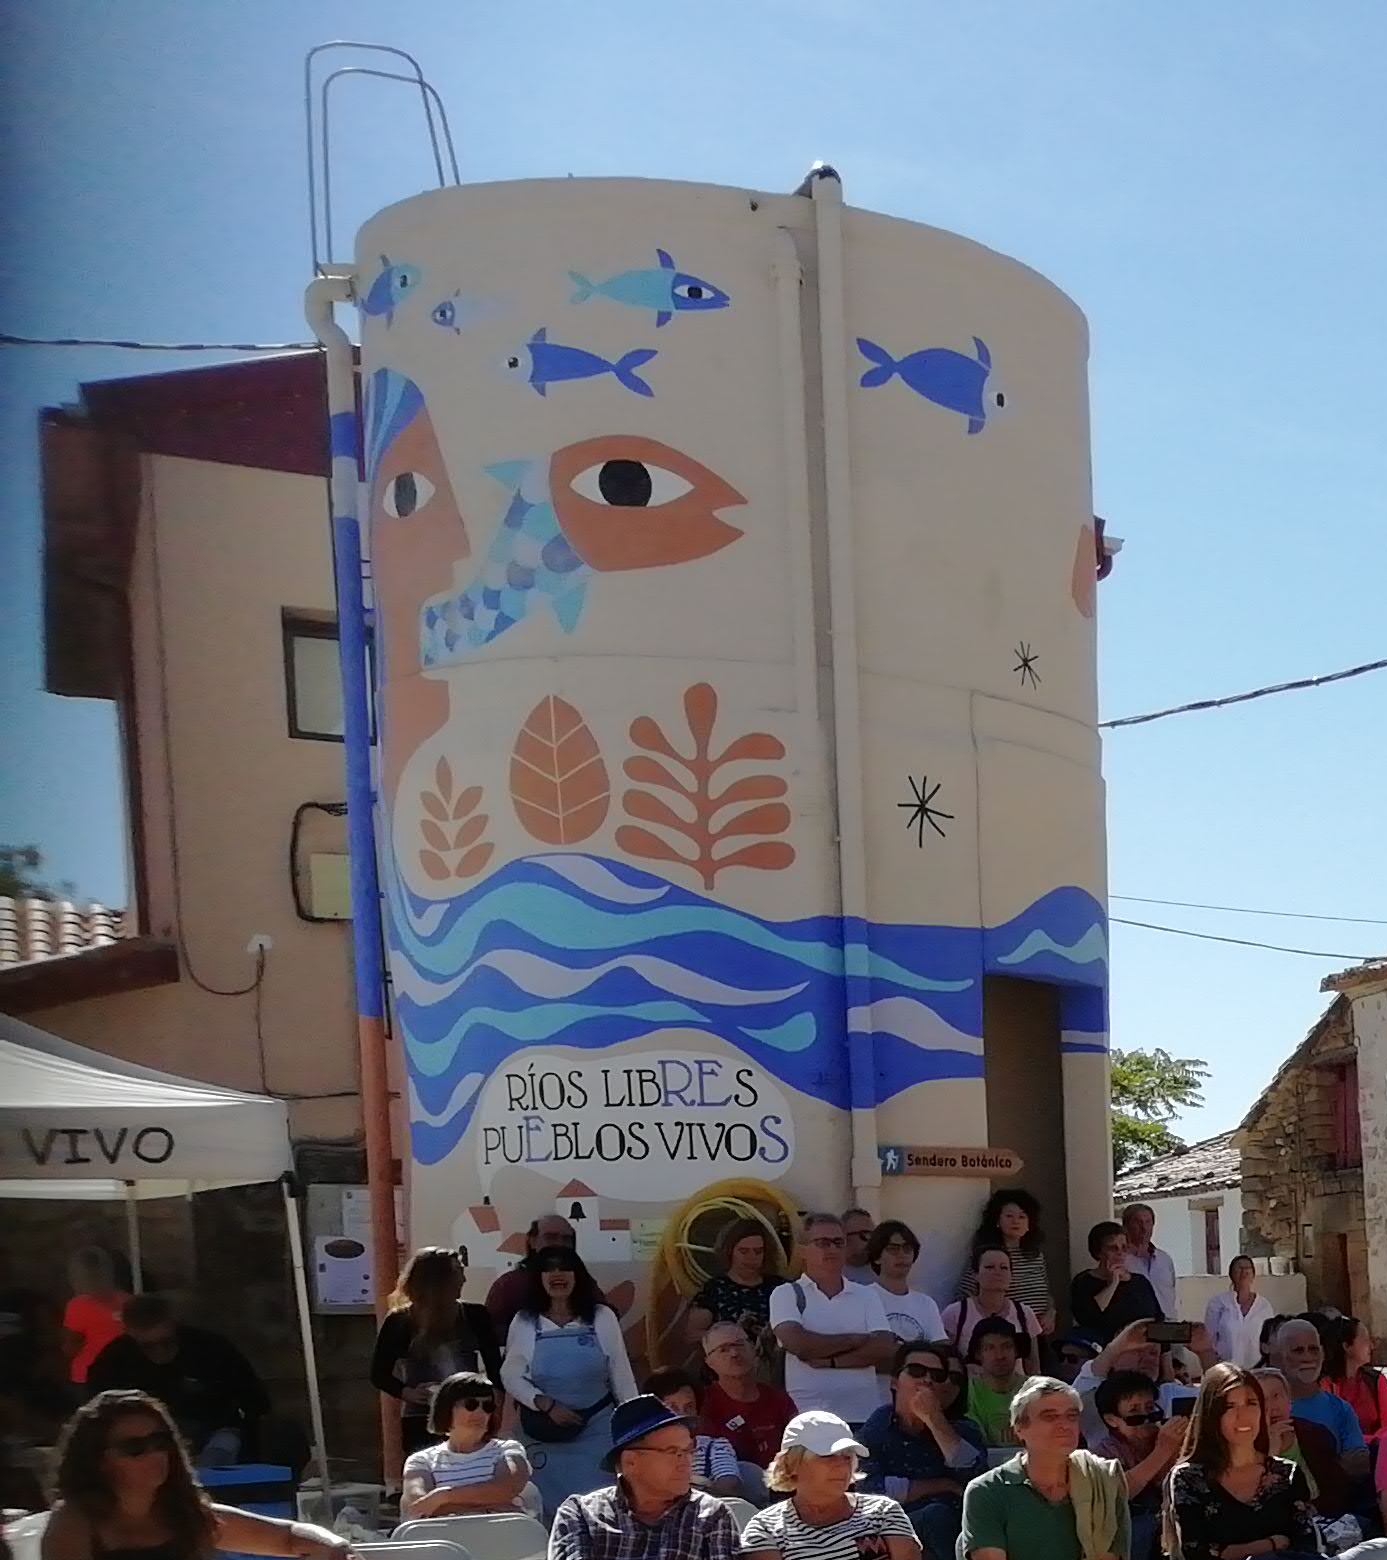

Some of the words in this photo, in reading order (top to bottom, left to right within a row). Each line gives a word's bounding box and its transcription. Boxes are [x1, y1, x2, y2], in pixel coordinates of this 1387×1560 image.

[505, 1062, 588, 1112] RÍOS
[600, 1060, 759, 1108] LIBRES
[20, 1126, 174, 1165] VIVO
[483, 1115, 650, 1165] PUEBLOS
[654, 1115, 789, 1163] VIVOS
[907, 1153, 957, 1167] Sendero
[961, 1154, 1013, 1169] Botánico
